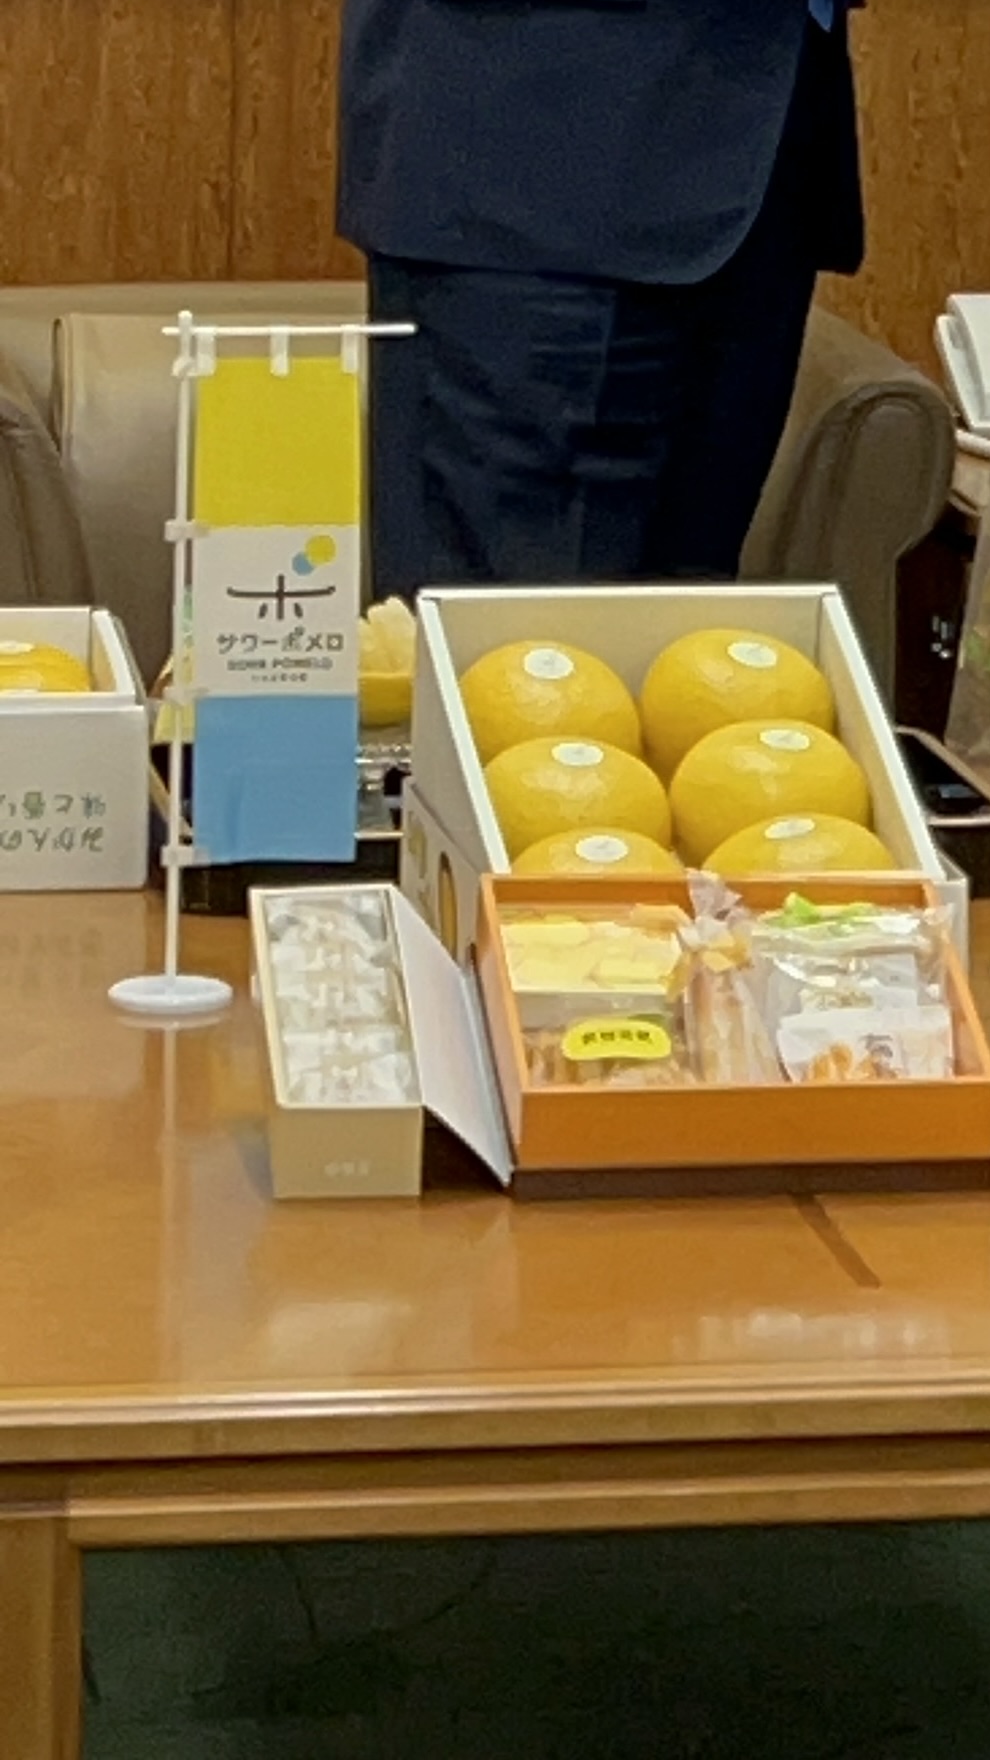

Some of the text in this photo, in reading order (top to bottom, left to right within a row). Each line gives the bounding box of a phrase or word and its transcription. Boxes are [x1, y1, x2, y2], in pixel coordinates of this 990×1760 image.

[217, 626, 344, 654] サワーポメロ
